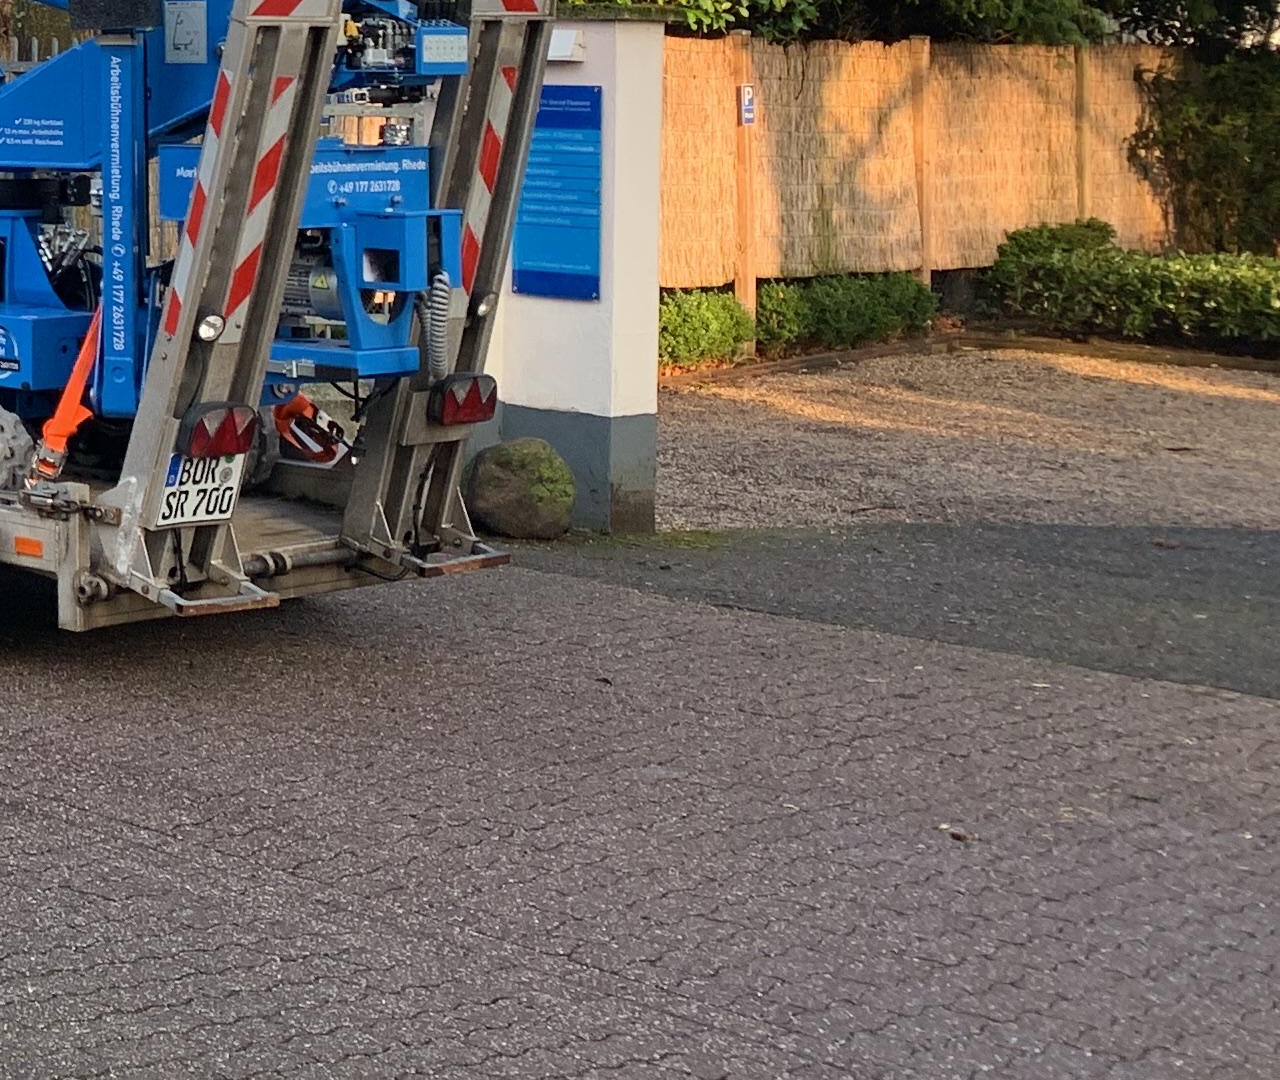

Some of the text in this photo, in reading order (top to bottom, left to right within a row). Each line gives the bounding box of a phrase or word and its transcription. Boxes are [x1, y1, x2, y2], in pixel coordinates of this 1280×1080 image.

[745, 86, 753, 106] P
[402, 159, 426, 170] Rhede
[355, 181, 368, 193] 177
[111, 206, 123, 241] Rhede
[112, 284, 125, 303] 177
[112, 306, 125, 351] 2631728
[179, 456, 220, 486] BOR
[162, 487, 234, 520] SR 700
